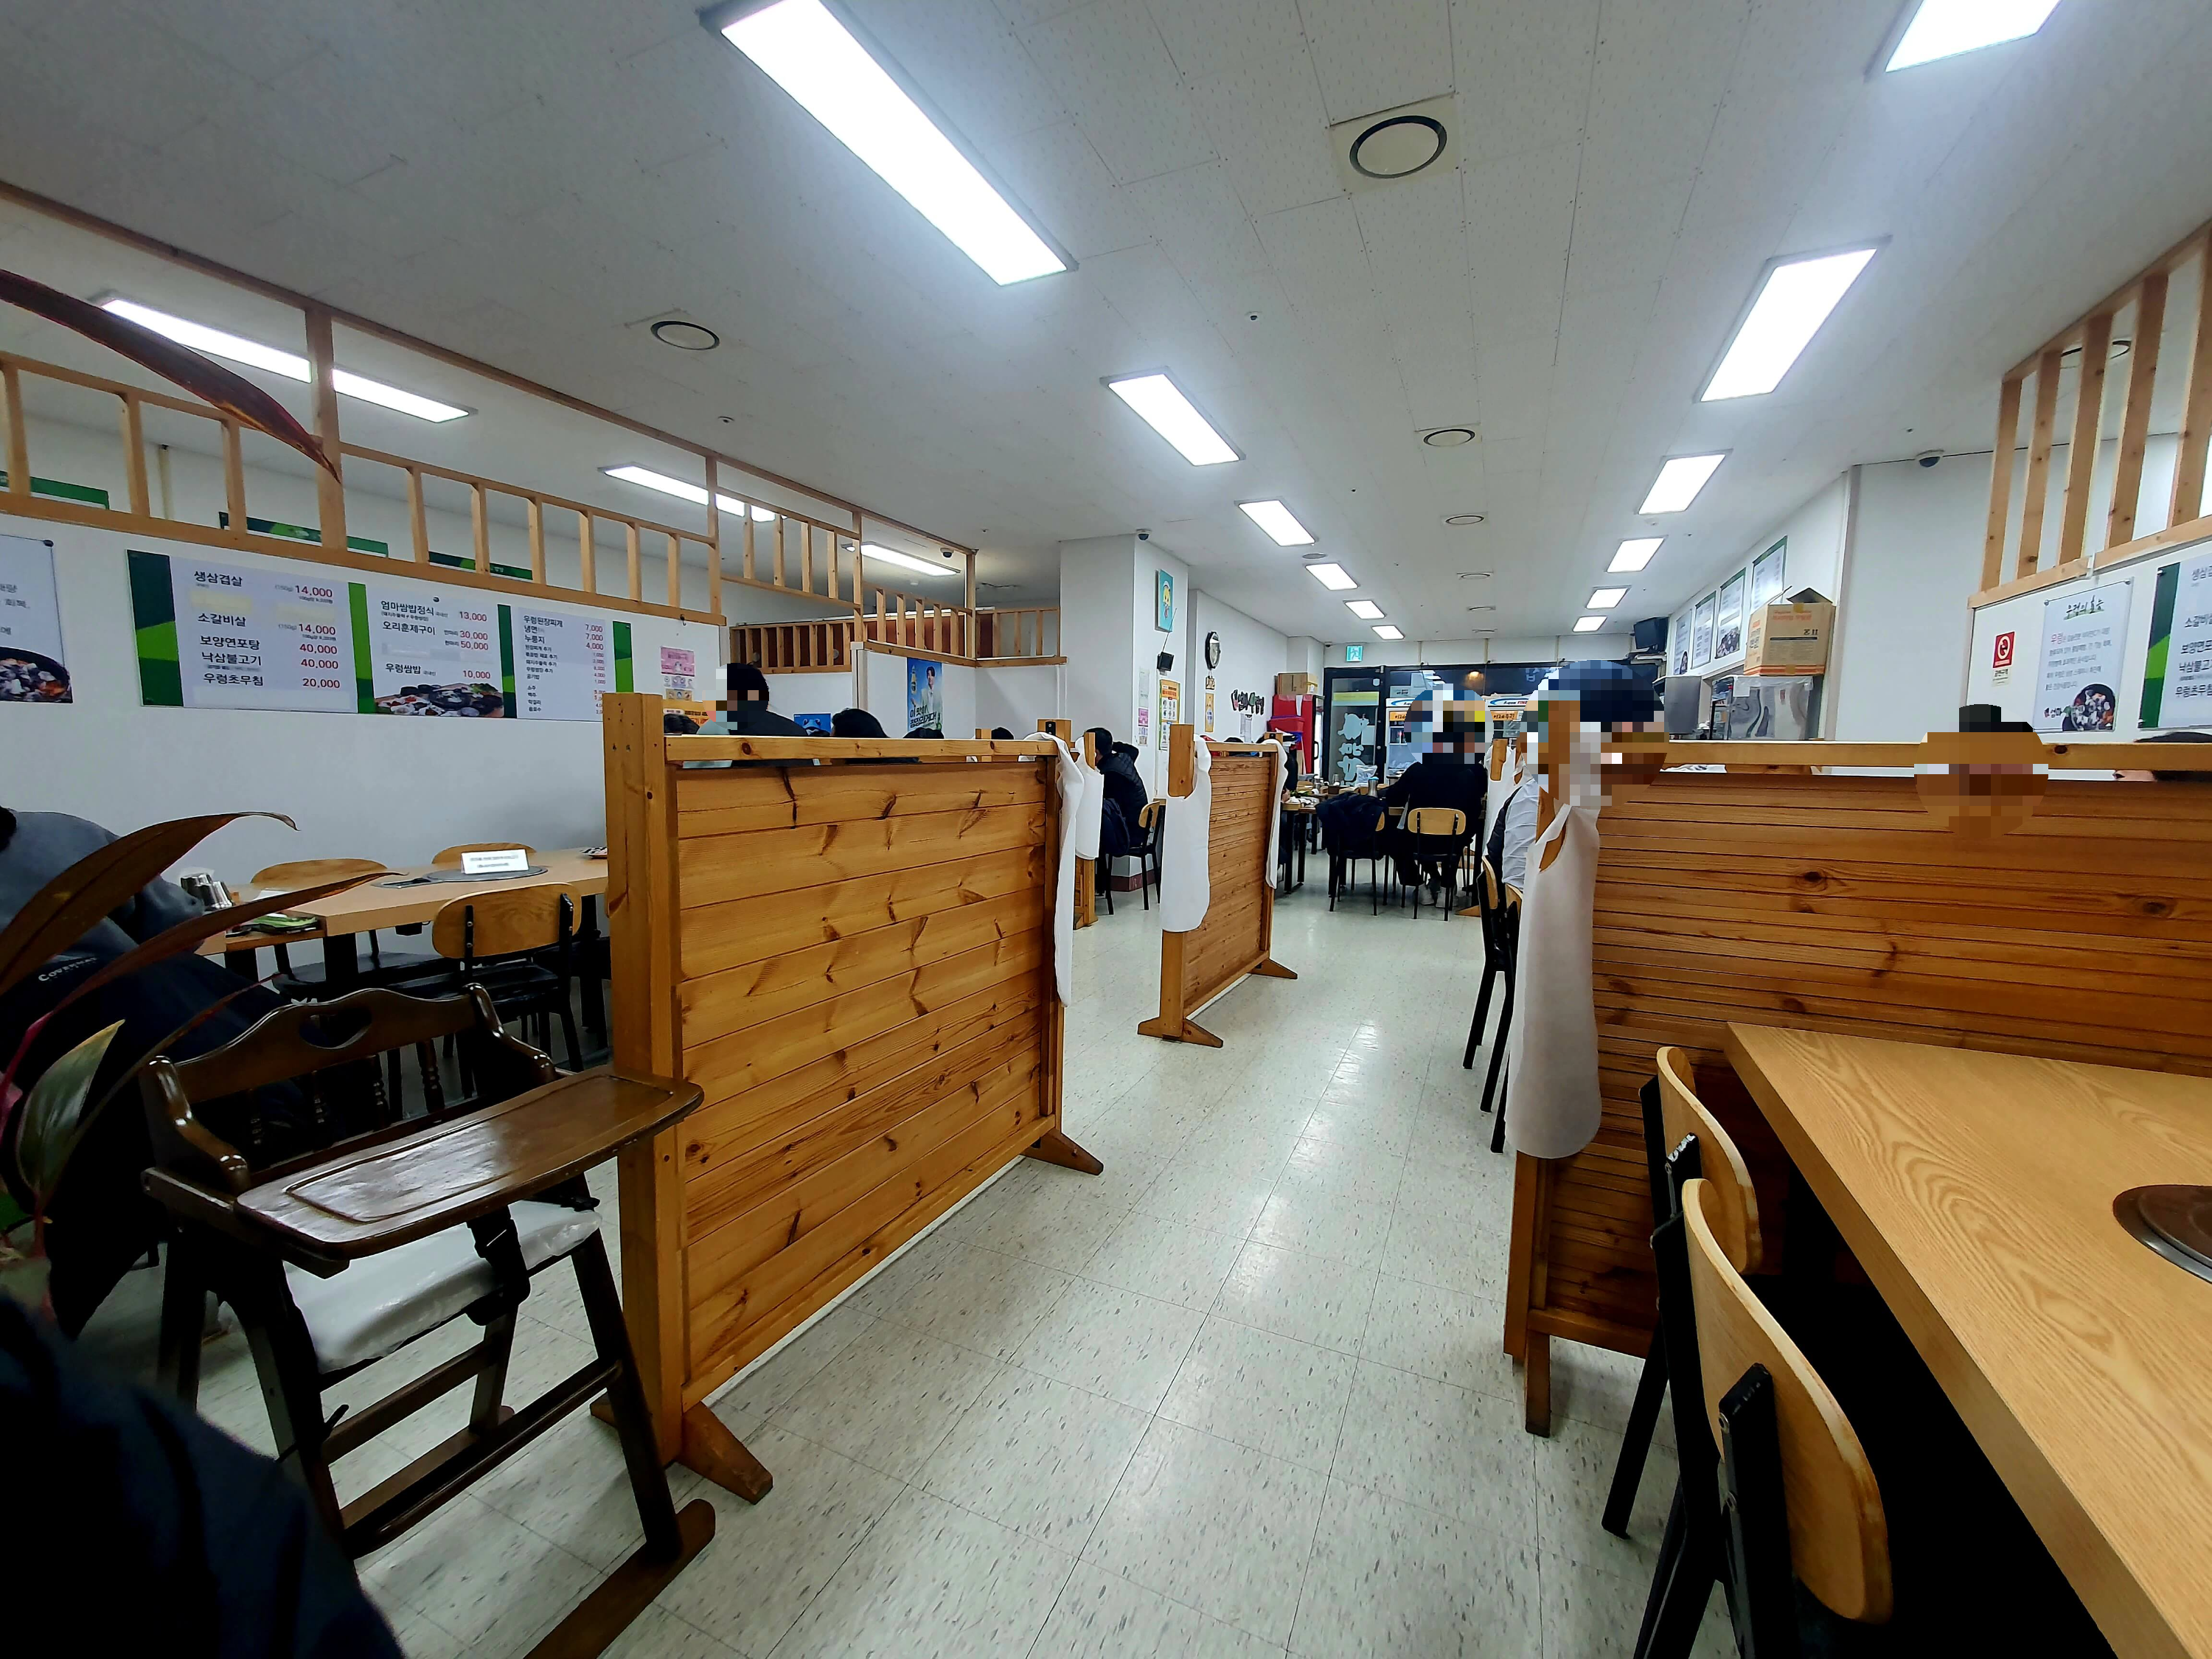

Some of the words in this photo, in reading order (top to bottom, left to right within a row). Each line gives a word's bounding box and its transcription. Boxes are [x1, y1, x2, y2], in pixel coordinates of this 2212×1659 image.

[194, 571, 243, 587] 생삼겹살
[380, 600, 434, 616] 엄마쌈밥정식
[198, 613, 246, 627] 소갈비살
[524, 615, 563, 627] 우렁된장찌개
[383, 621, 436, 636] 오리훈제구이
[200, 636, 260, 650] 보양연포탕
[524, 635, 545, 644] 누룽지
[201, 652, 262, 667] 낙삼불고기
[2179, 658, 2212, 673] 낙삼불고
[386, 663, 422, 675] 우렁쌈밥
[204, 672, 264, 686] 우렁초무침
